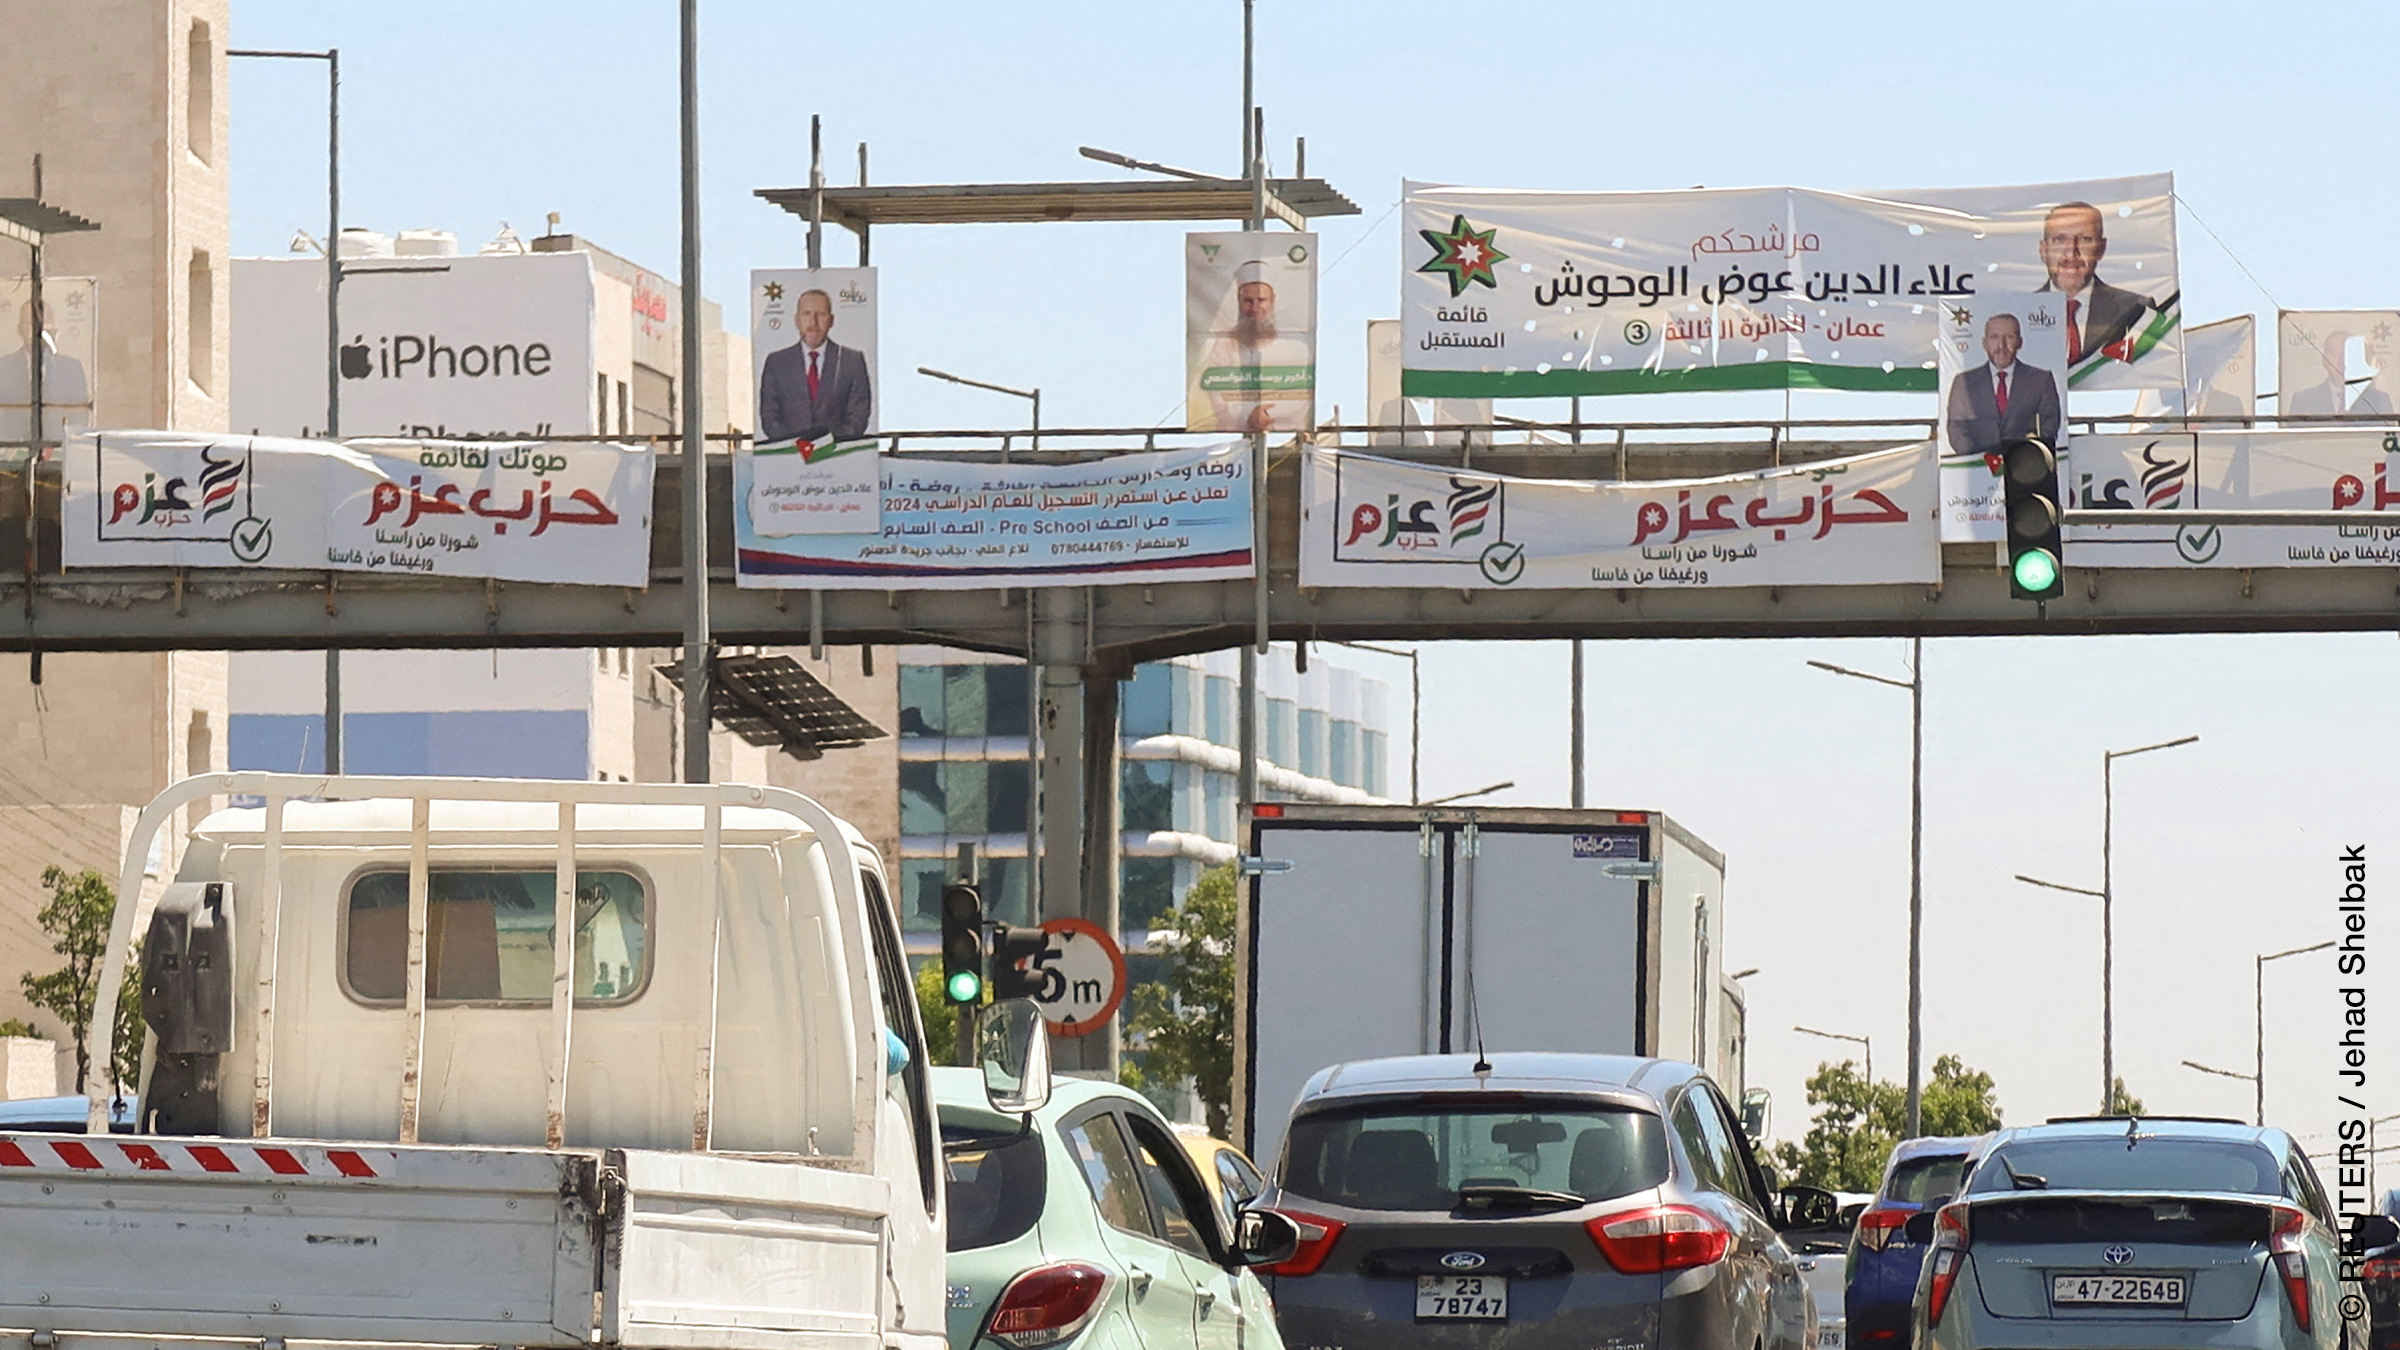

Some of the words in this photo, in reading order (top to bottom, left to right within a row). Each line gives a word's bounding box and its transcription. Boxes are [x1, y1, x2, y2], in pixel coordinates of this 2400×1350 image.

[1691, 223, 1821, 262] مرشحكم
[1534, 260, 1688, 307] الوحوش
[1701, 264, 1795, 305] عوض
[1804, 264, 1900, 302] الدين
[1908, 264, 1976, 296] علاء
[1437, 305, 1488, 323] قائمة
[1740, 313, 1806, 343] الدائرة
[1826, 316, 1886, 342] عمان
[1420, 330, 1505, 351] المستقبل
[381, 334, 552, 380] iPhone
[419, 446, 489, 470] لقائمة
[499, 446, 567, 477] صوتك
[1197, 460, 1242, 479] روضة
[909, 478, 961, 494] روضة
[107, 473, 194, 525] عزم
[362, 475, 466, 529] عزم
[885, 498, 921, 511] 2024
[924, 494, 988, 513] الدراسي
[991, 493, 1034, 512] للعام
[1038, 491, 1098, 511] التسجيل
[1102, 488, 1158, 509] استمرار
[1163, 488, 1188, 505] عن
[468, 480, 619, 537] حزب
[1628, 490, 1741, 546] عزم
[1745, 485, 1909, 541] حزب
[154, 511, 191, 527] حزب
[940, 520, 984, 534] الصف
[1033, 519, 1091, 535] School
[1095, 515, 1138, 531] الصف
[1143, 515, 1170, 530] من
[1344, 493, 1441, 547] عزم
[883, 520, 937, 539] السابع
[416, 533, 435, 548] من
[1398, 532, 1438, 550] حزب
[367, 549, 386, 568] من
[1686, 545, 1706, 562] من
[1712, 543, 1757, 562] شورنا
[2329, 546, 2350, 564] من
[1633, 566, 1654, 584] من
[1455, 1278, 1482, 1296] 23
[2077, 1279, 2180, 1301] 47-22648
[1433, 1297, 1503, 1316] 78747
